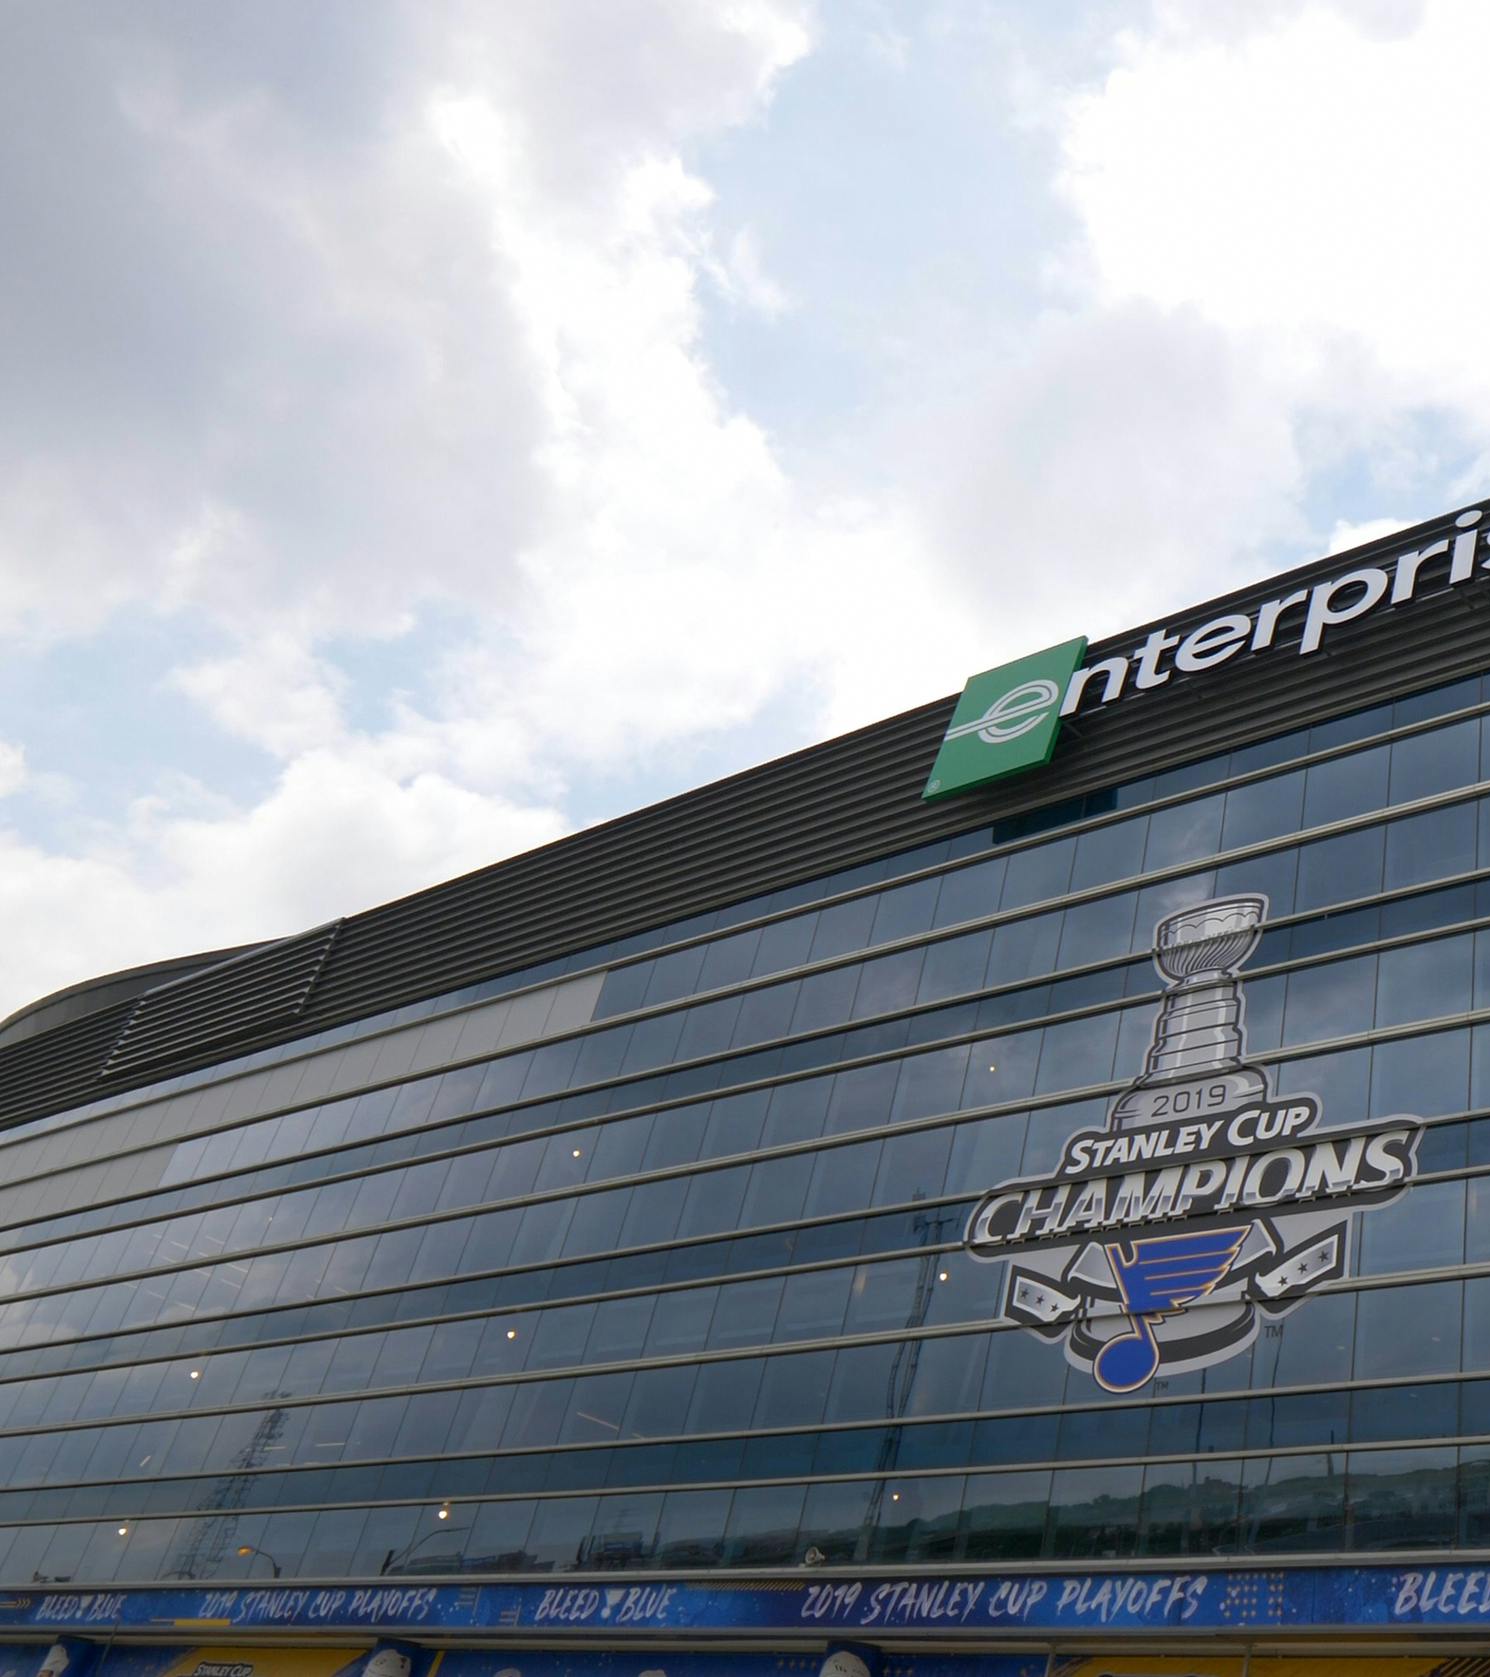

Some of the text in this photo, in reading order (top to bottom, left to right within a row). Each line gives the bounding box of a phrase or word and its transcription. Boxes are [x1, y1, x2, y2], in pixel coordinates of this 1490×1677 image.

[1150, 1083, 1227, 1119] 2019
[1064, 1105, 1310, 1175] STANLEY CUP
[974, 1128, 1411, 1246] CHAMPIONS
[1264, 1325, 1284, 1339] TM
[35, 1593, 128, 1621] BLEED BLUE
[199, 1587, 438, 1624] 2019 STANLEY CUP PLAYOFFS
[534, 1584, 677, 1624] BLEED BLUE
[800, 1575, 1208, 1625] 2019 STANLEY CUP PLAYOFFS
